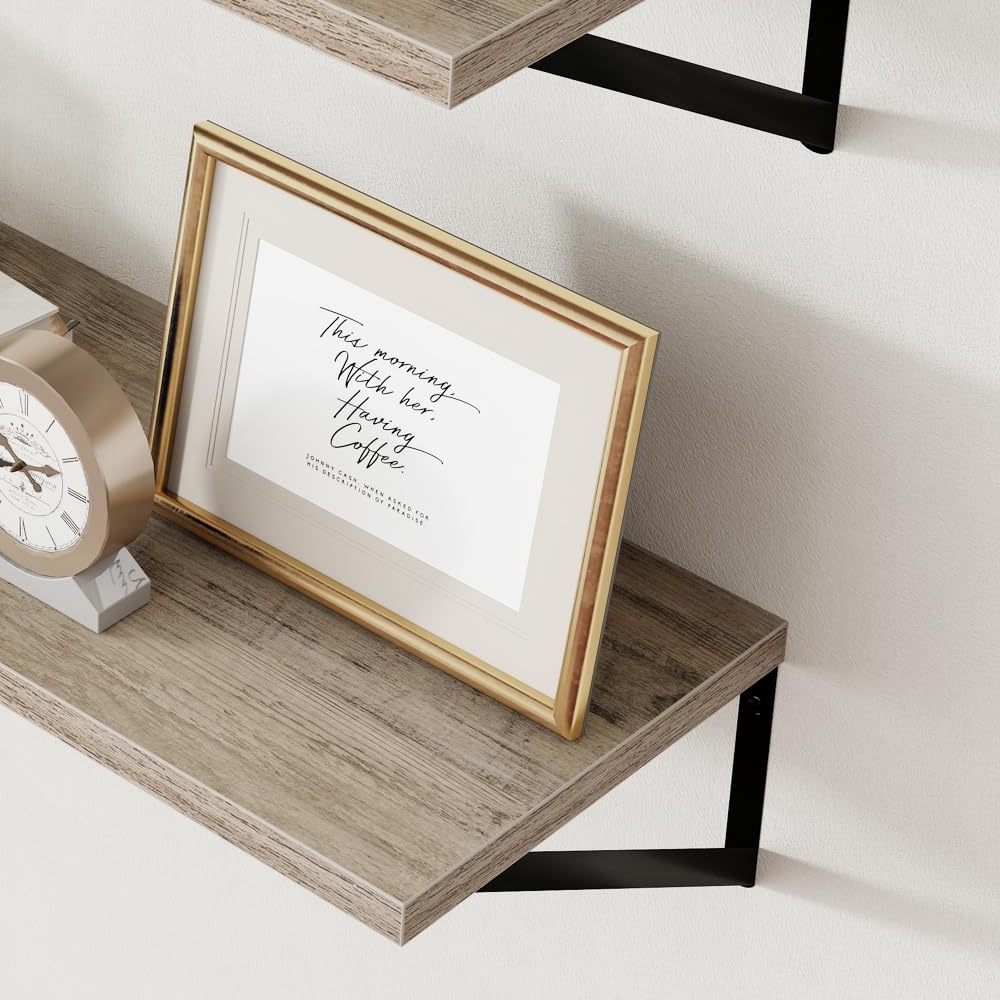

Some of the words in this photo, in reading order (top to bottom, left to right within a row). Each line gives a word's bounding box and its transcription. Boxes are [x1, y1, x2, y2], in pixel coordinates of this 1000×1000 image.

[319, 306, 369, 349] This
[334, 350, 395, 396] With
[399, 387, 436, 422] her,
[329, 422, 405, 474] Coffee.
[332, 389, 444, 465] Having
[304, 452, 335, 471] JOHNNY
[363, 483, 384, 498] WHEN
[387, 496, 412, 512] ASKED
[415, 510, 429, 520] FOR
[322, 469, 372, 498] DESCRIPTION
[374, 496, 384, 504] OF
